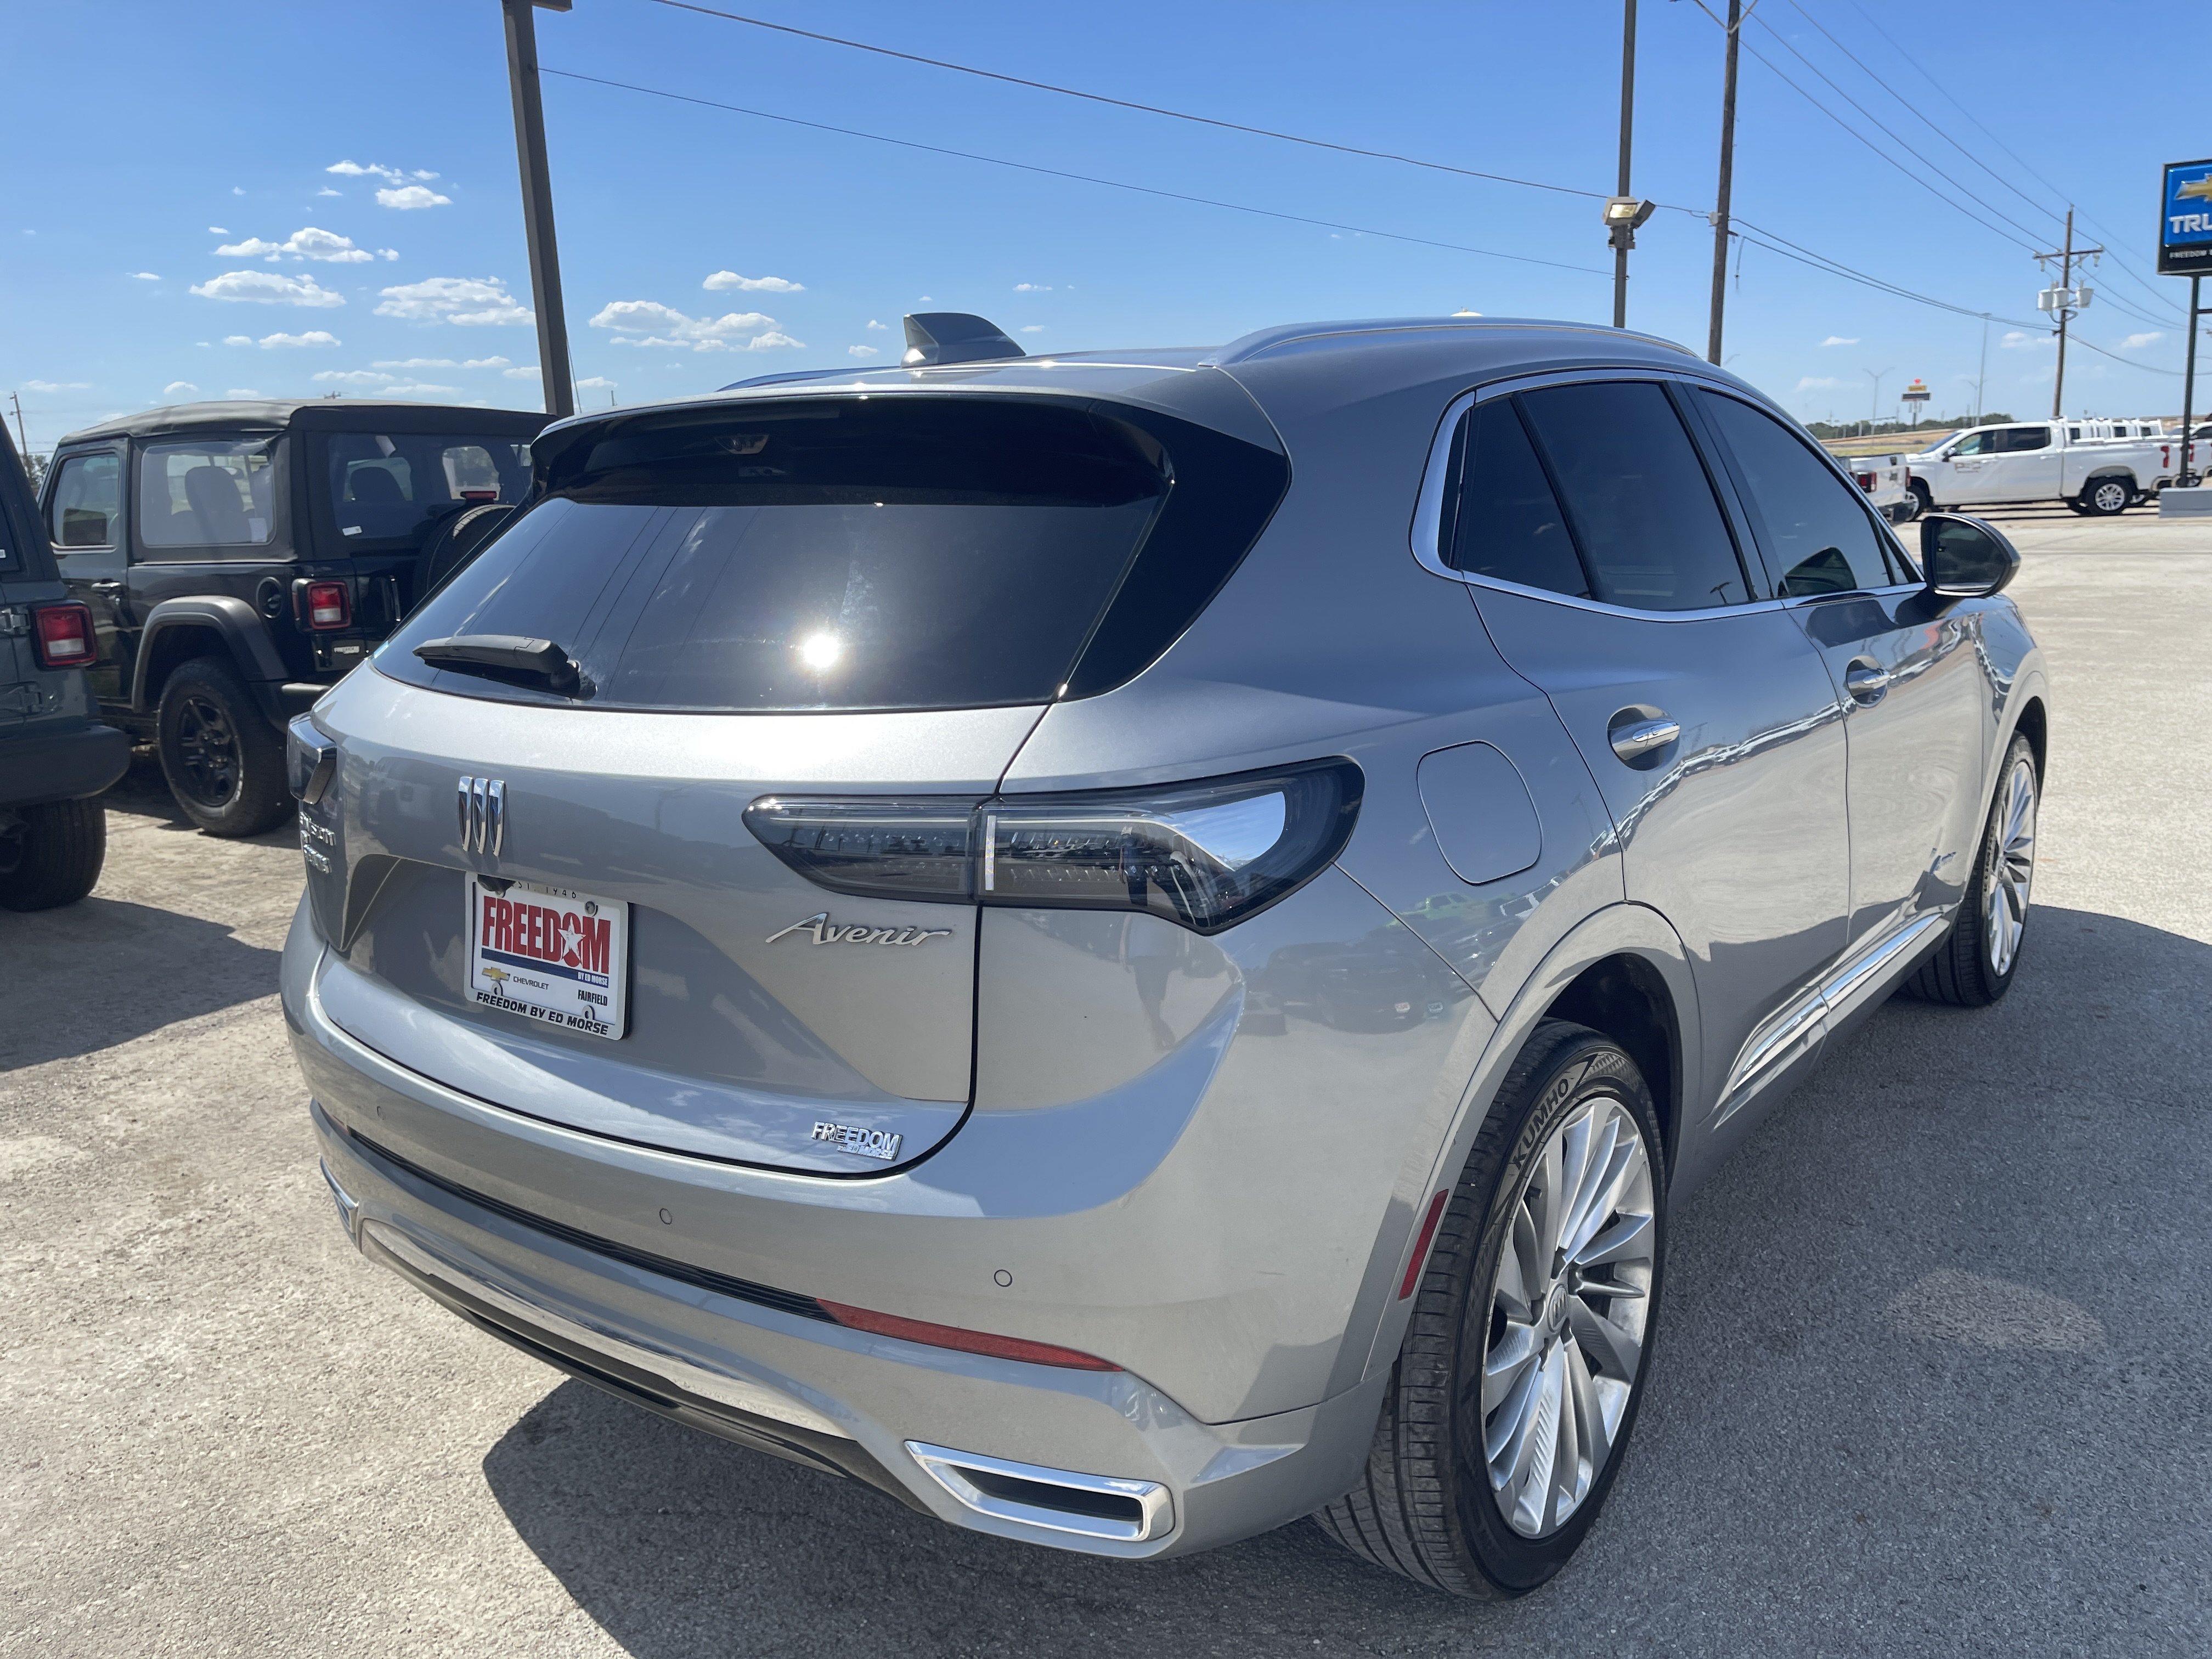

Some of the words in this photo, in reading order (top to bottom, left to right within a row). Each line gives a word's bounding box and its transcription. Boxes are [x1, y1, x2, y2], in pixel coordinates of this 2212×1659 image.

[482, 895, 611, 975] FREEDOM
[765, 912, 952, 946] Avenir
[514, 976, 549, 990] CHEVROLET
[578, 971, 585, 980] BY
[585, 973, 591, 982] ED
[591, 974, 608, 986] MORSE
[476, 991, 527, 1014] FREEDOM
[530, 1006, 546, 1018] BY
[548, 1011, 563, 1023] ED
[567, 1016, 608, 1036] MORSE
[578, 989, 608, 1006] FAIRFIELD
[811, 1121, 902, 1153] FREEDOM
[1511, 1079, 1569, 1171] KUMHO
[845, 1143, 859, 1153] ED
[857, 1146, 895, 1160] MORSE
